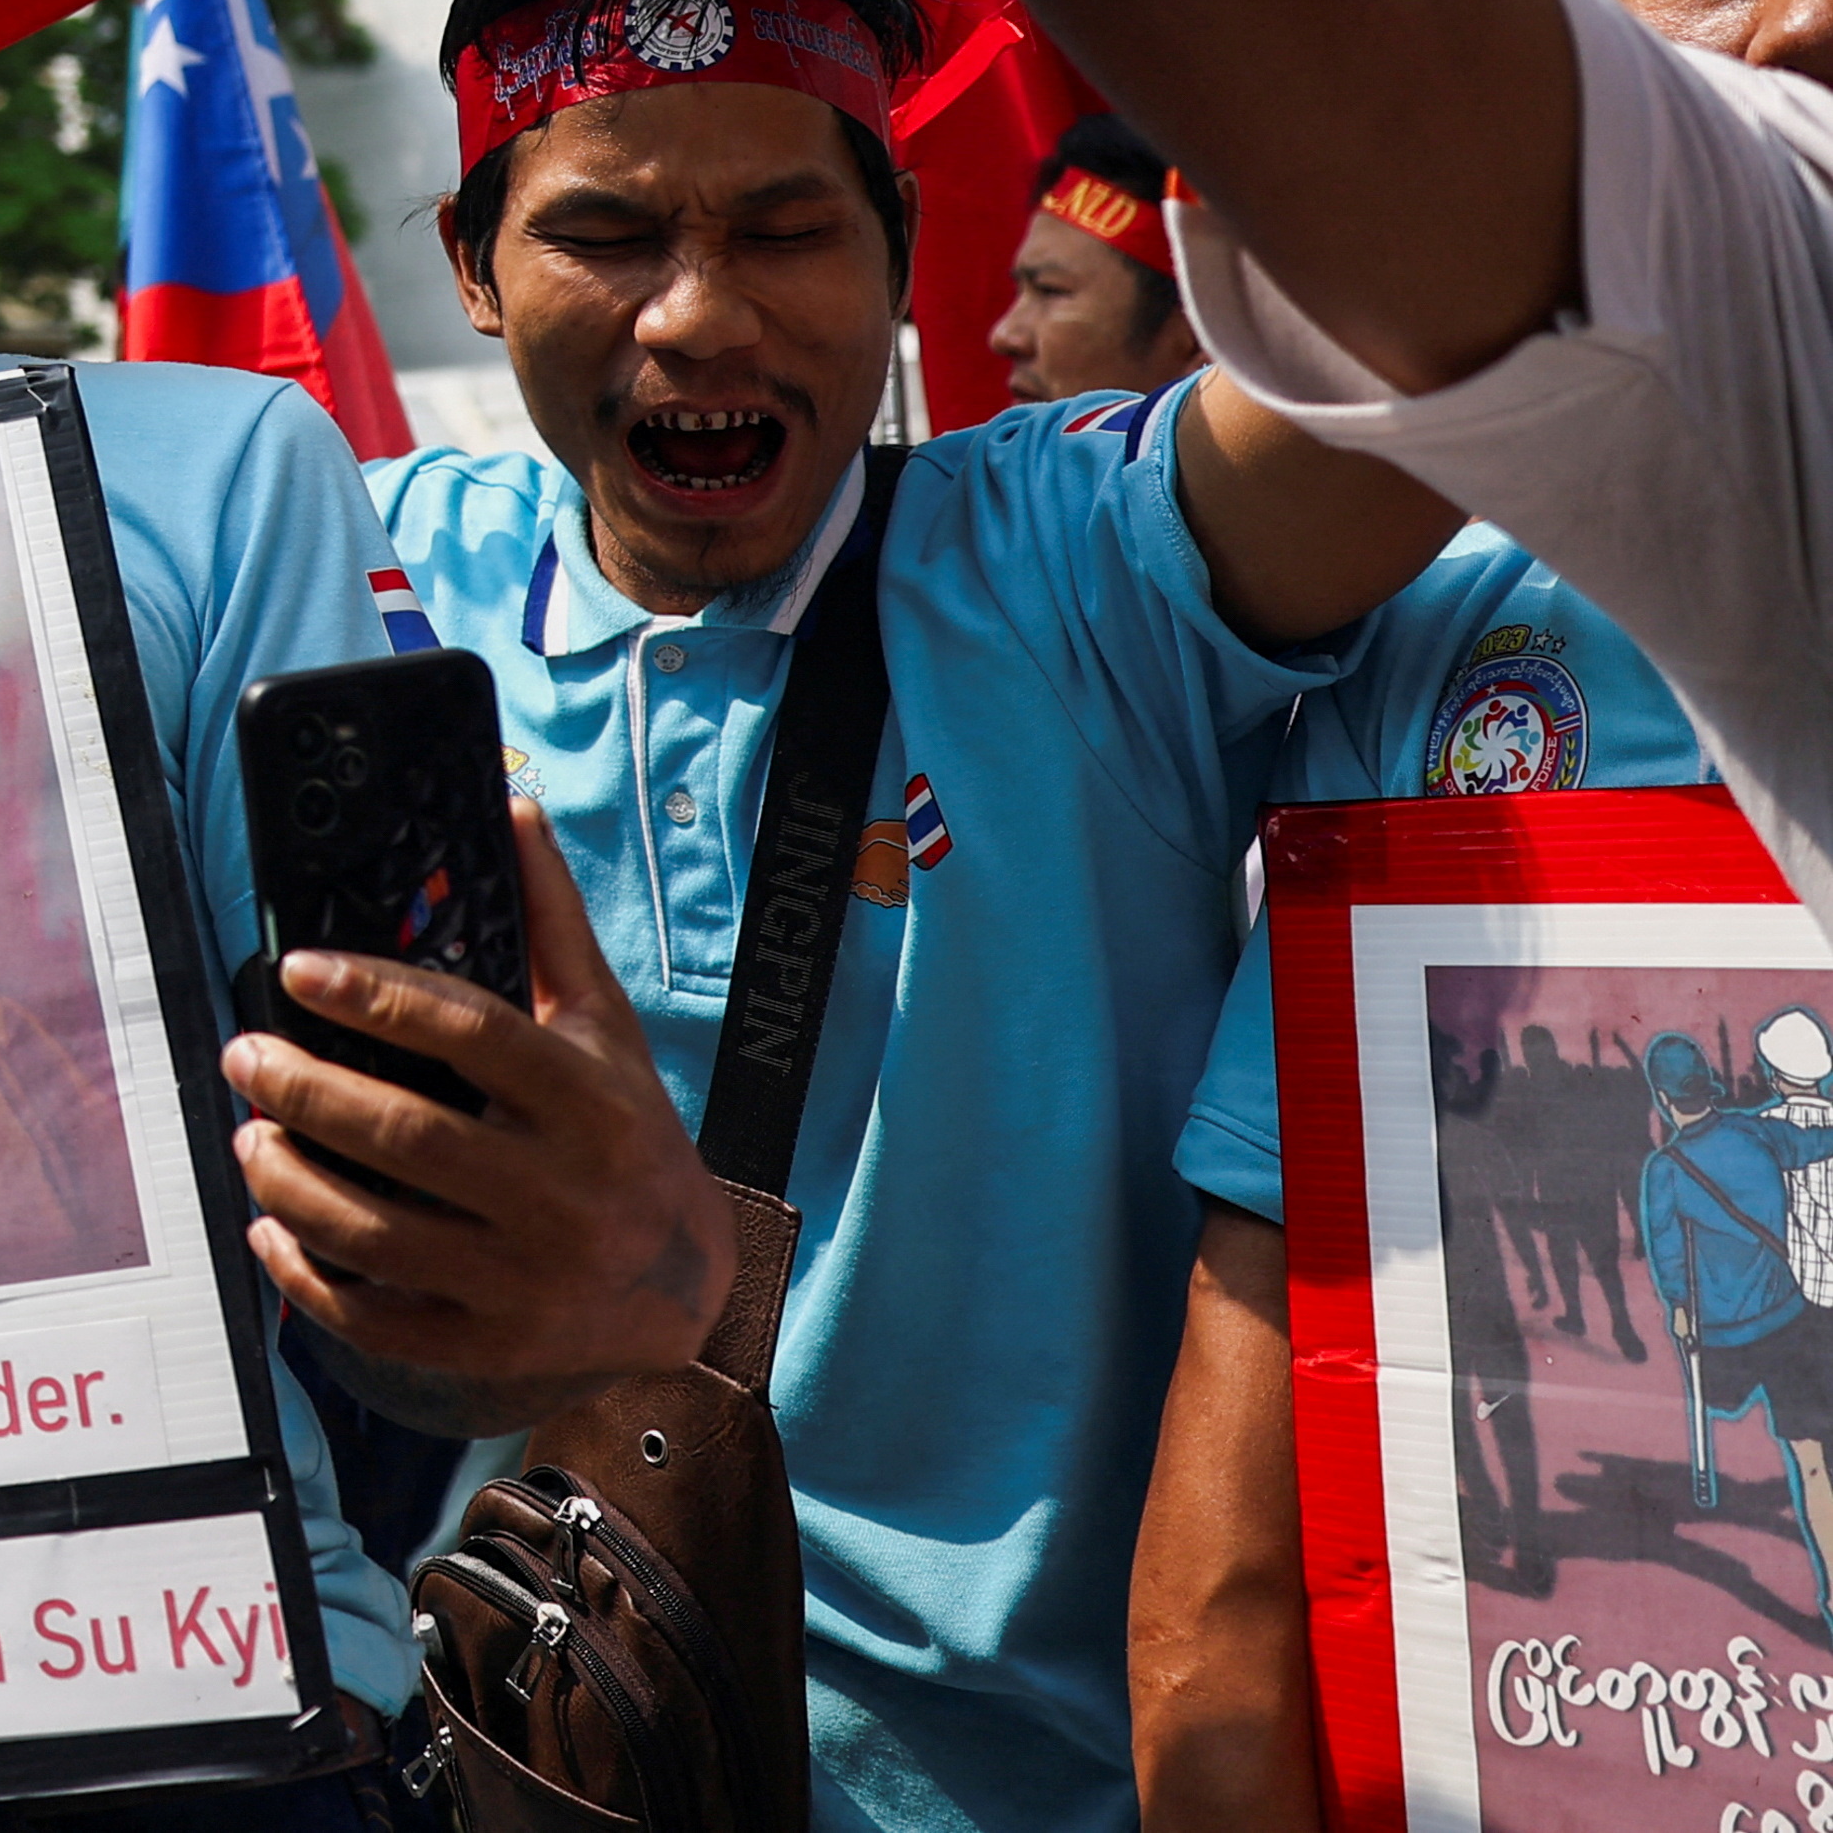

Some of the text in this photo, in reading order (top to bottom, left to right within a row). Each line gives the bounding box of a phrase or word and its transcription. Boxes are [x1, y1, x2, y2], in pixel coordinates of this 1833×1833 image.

[1061, 176, 1139, 239] NLD
[1531, 735, 1558, 792] FORCE
[737, 770, 845, 1078] JINGPIN
[34, 1597, 137, 1679] Su
[162, 1581, 287, 1688] Kyi
